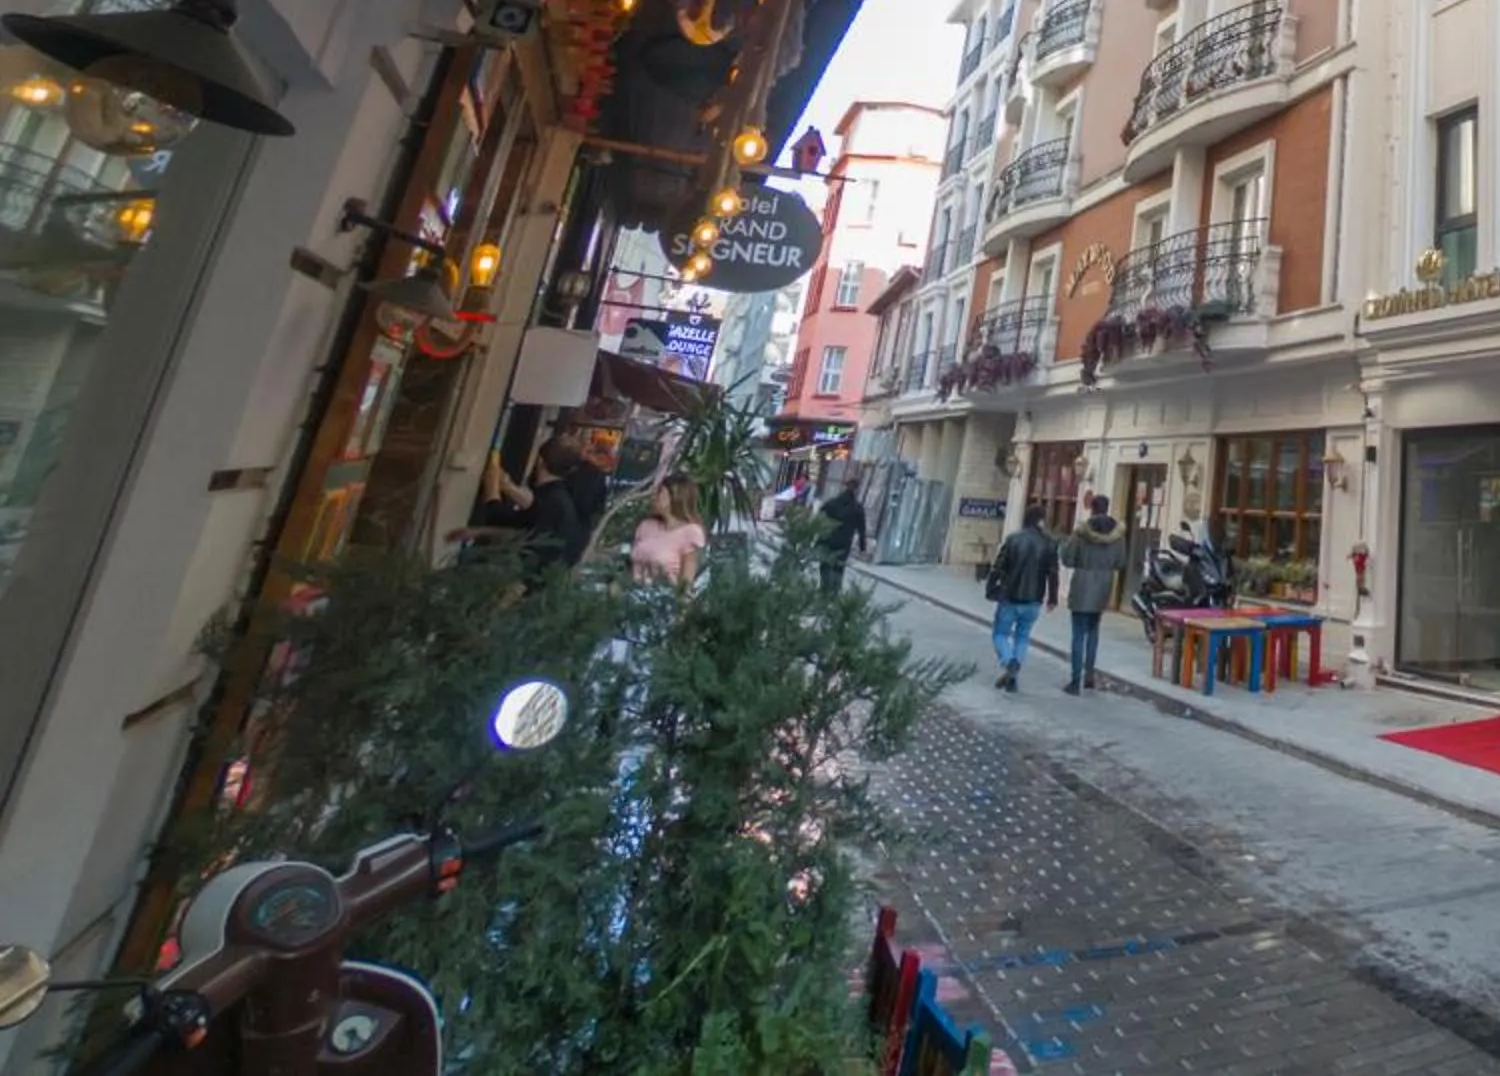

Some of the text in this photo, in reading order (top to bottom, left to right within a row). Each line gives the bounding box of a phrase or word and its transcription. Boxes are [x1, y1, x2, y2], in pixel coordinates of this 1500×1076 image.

[730, 194, 779, 216] otel
[714, 217, 788, 241] RAND
[671, 233, 804, 269] SGNEUR
